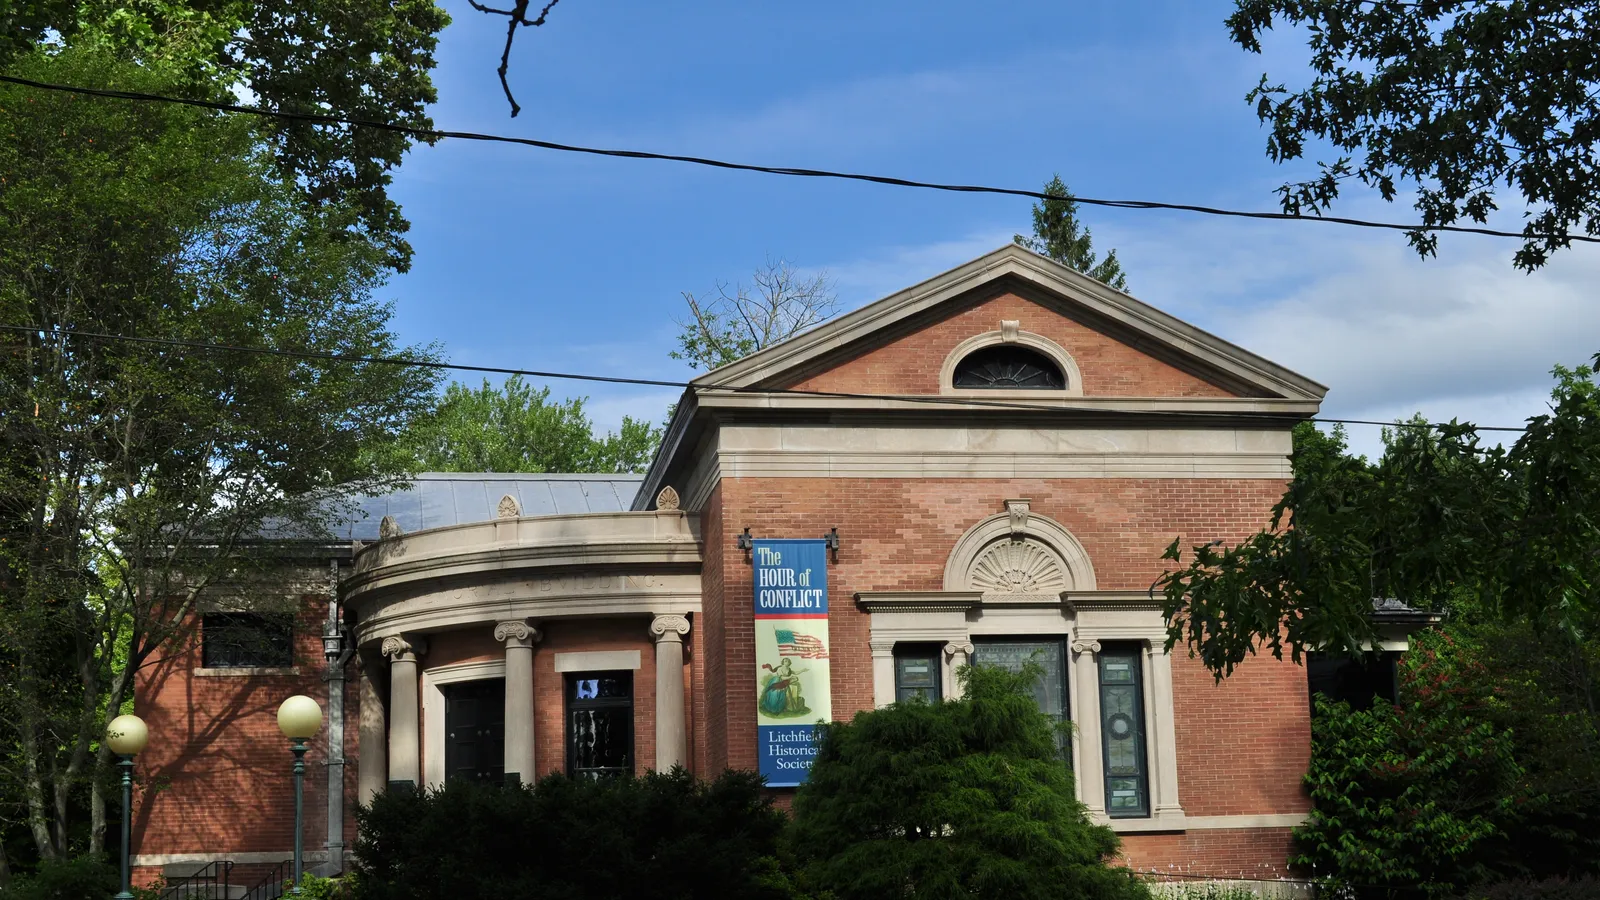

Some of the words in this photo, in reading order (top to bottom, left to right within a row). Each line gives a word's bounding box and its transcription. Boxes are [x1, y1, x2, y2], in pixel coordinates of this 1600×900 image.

[757, 547, 781, 566] The
[759, 568, 797, 587] HOUR
[799, 568, 812, 587] of
[760, 589, 823, 609] CONFLICT
